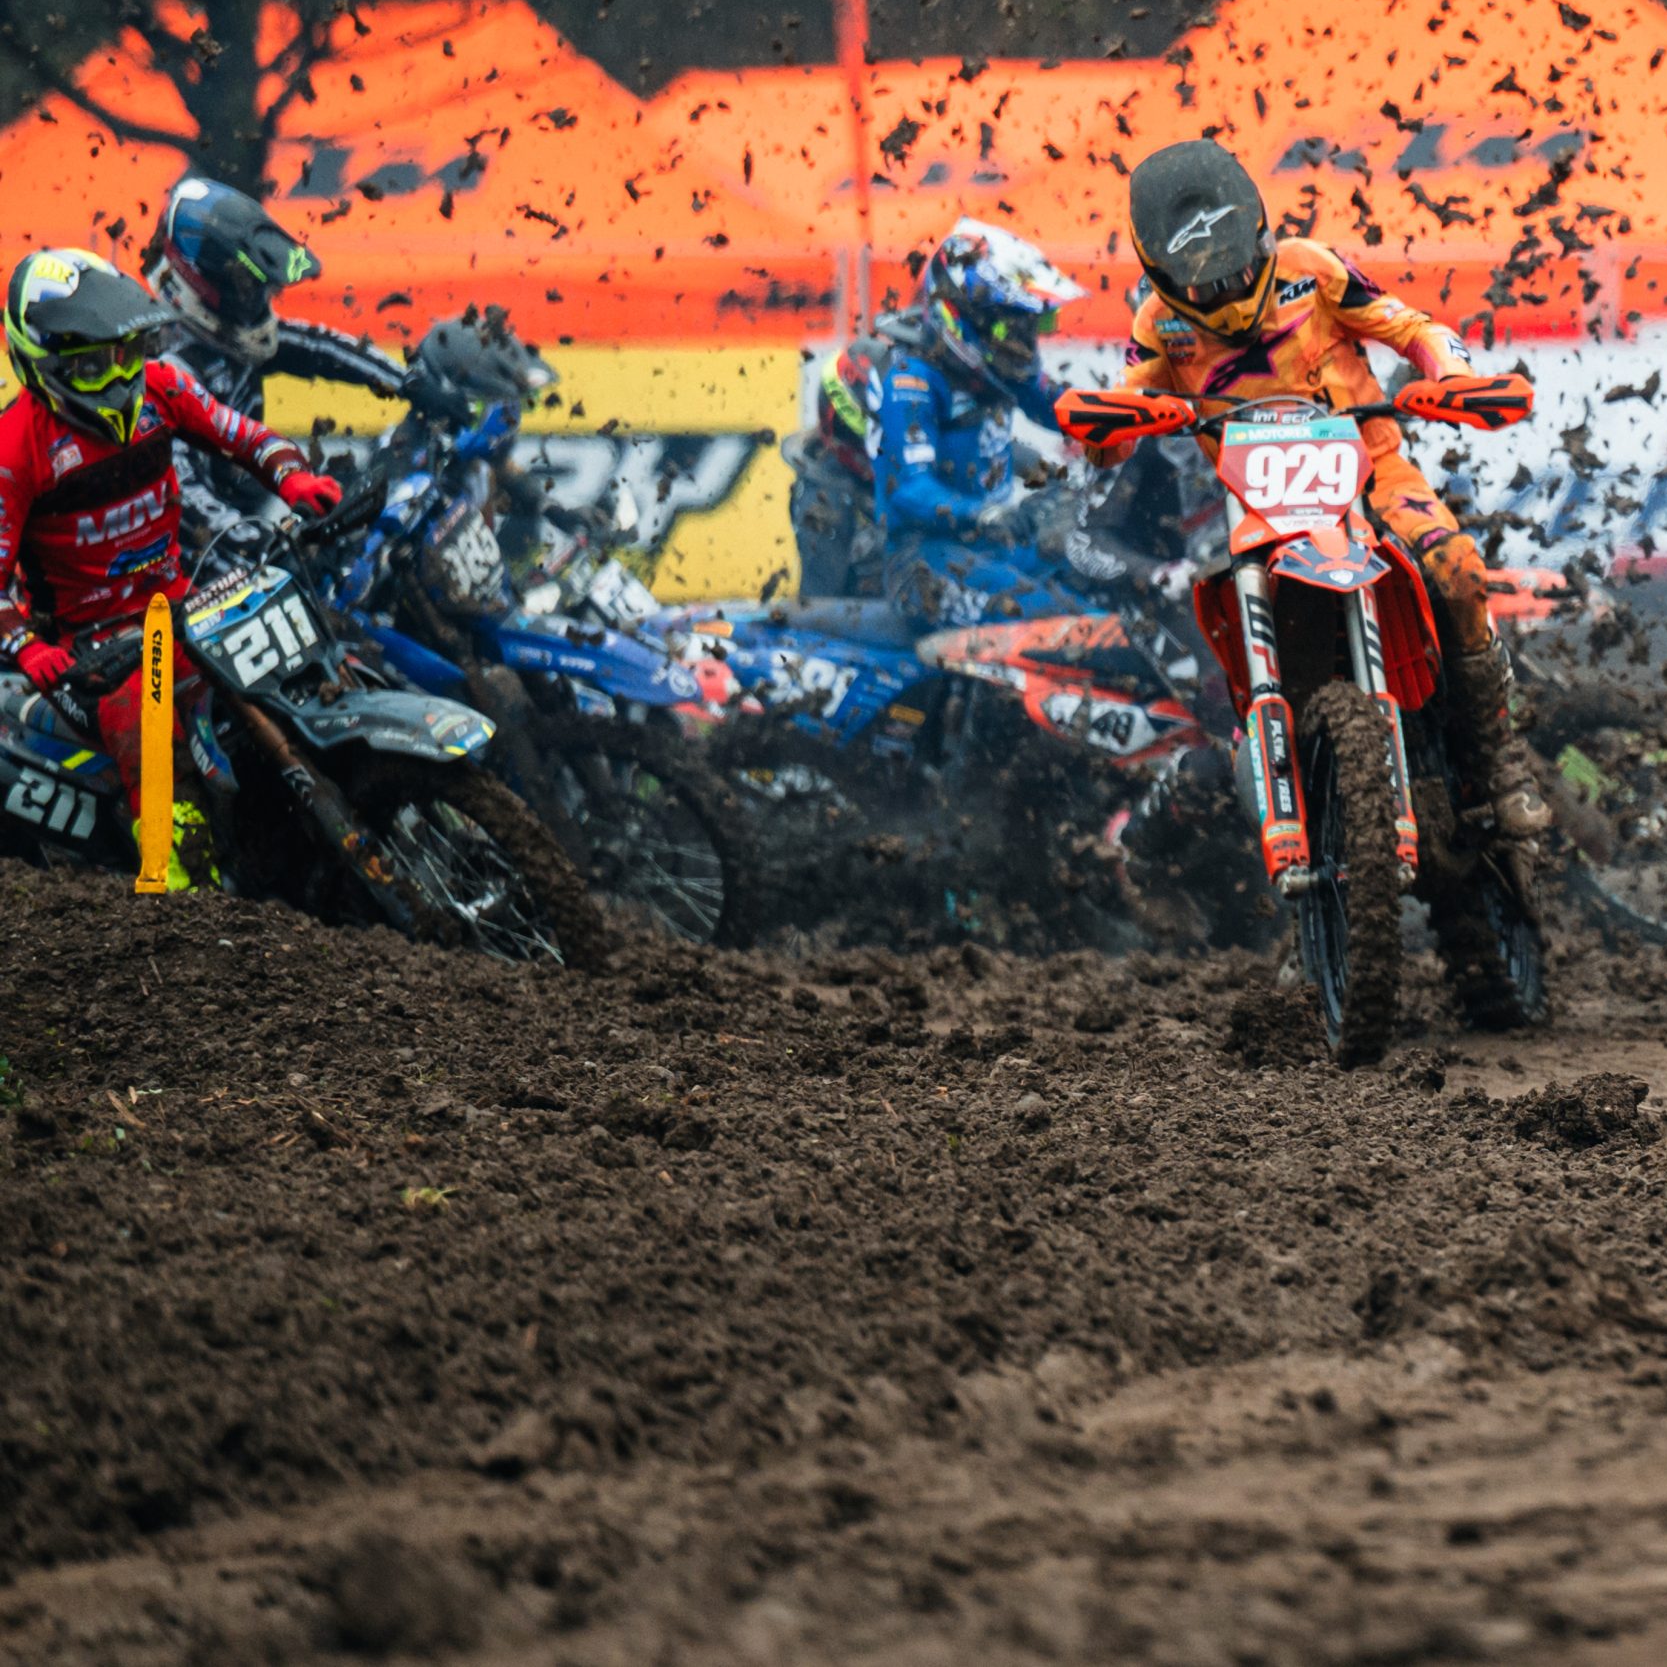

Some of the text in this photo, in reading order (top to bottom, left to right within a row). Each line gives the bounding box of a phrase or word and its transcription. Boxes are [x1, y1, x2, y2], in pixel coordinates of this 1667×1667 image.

[1278, 278, 1317, 307] KTM
[1248, 426, 1313, 441] MOTOREX
[1244, 442, 1359, 510] 929
[223, 594, 318, 689] 211
[4, 767, 98, 841] 211
